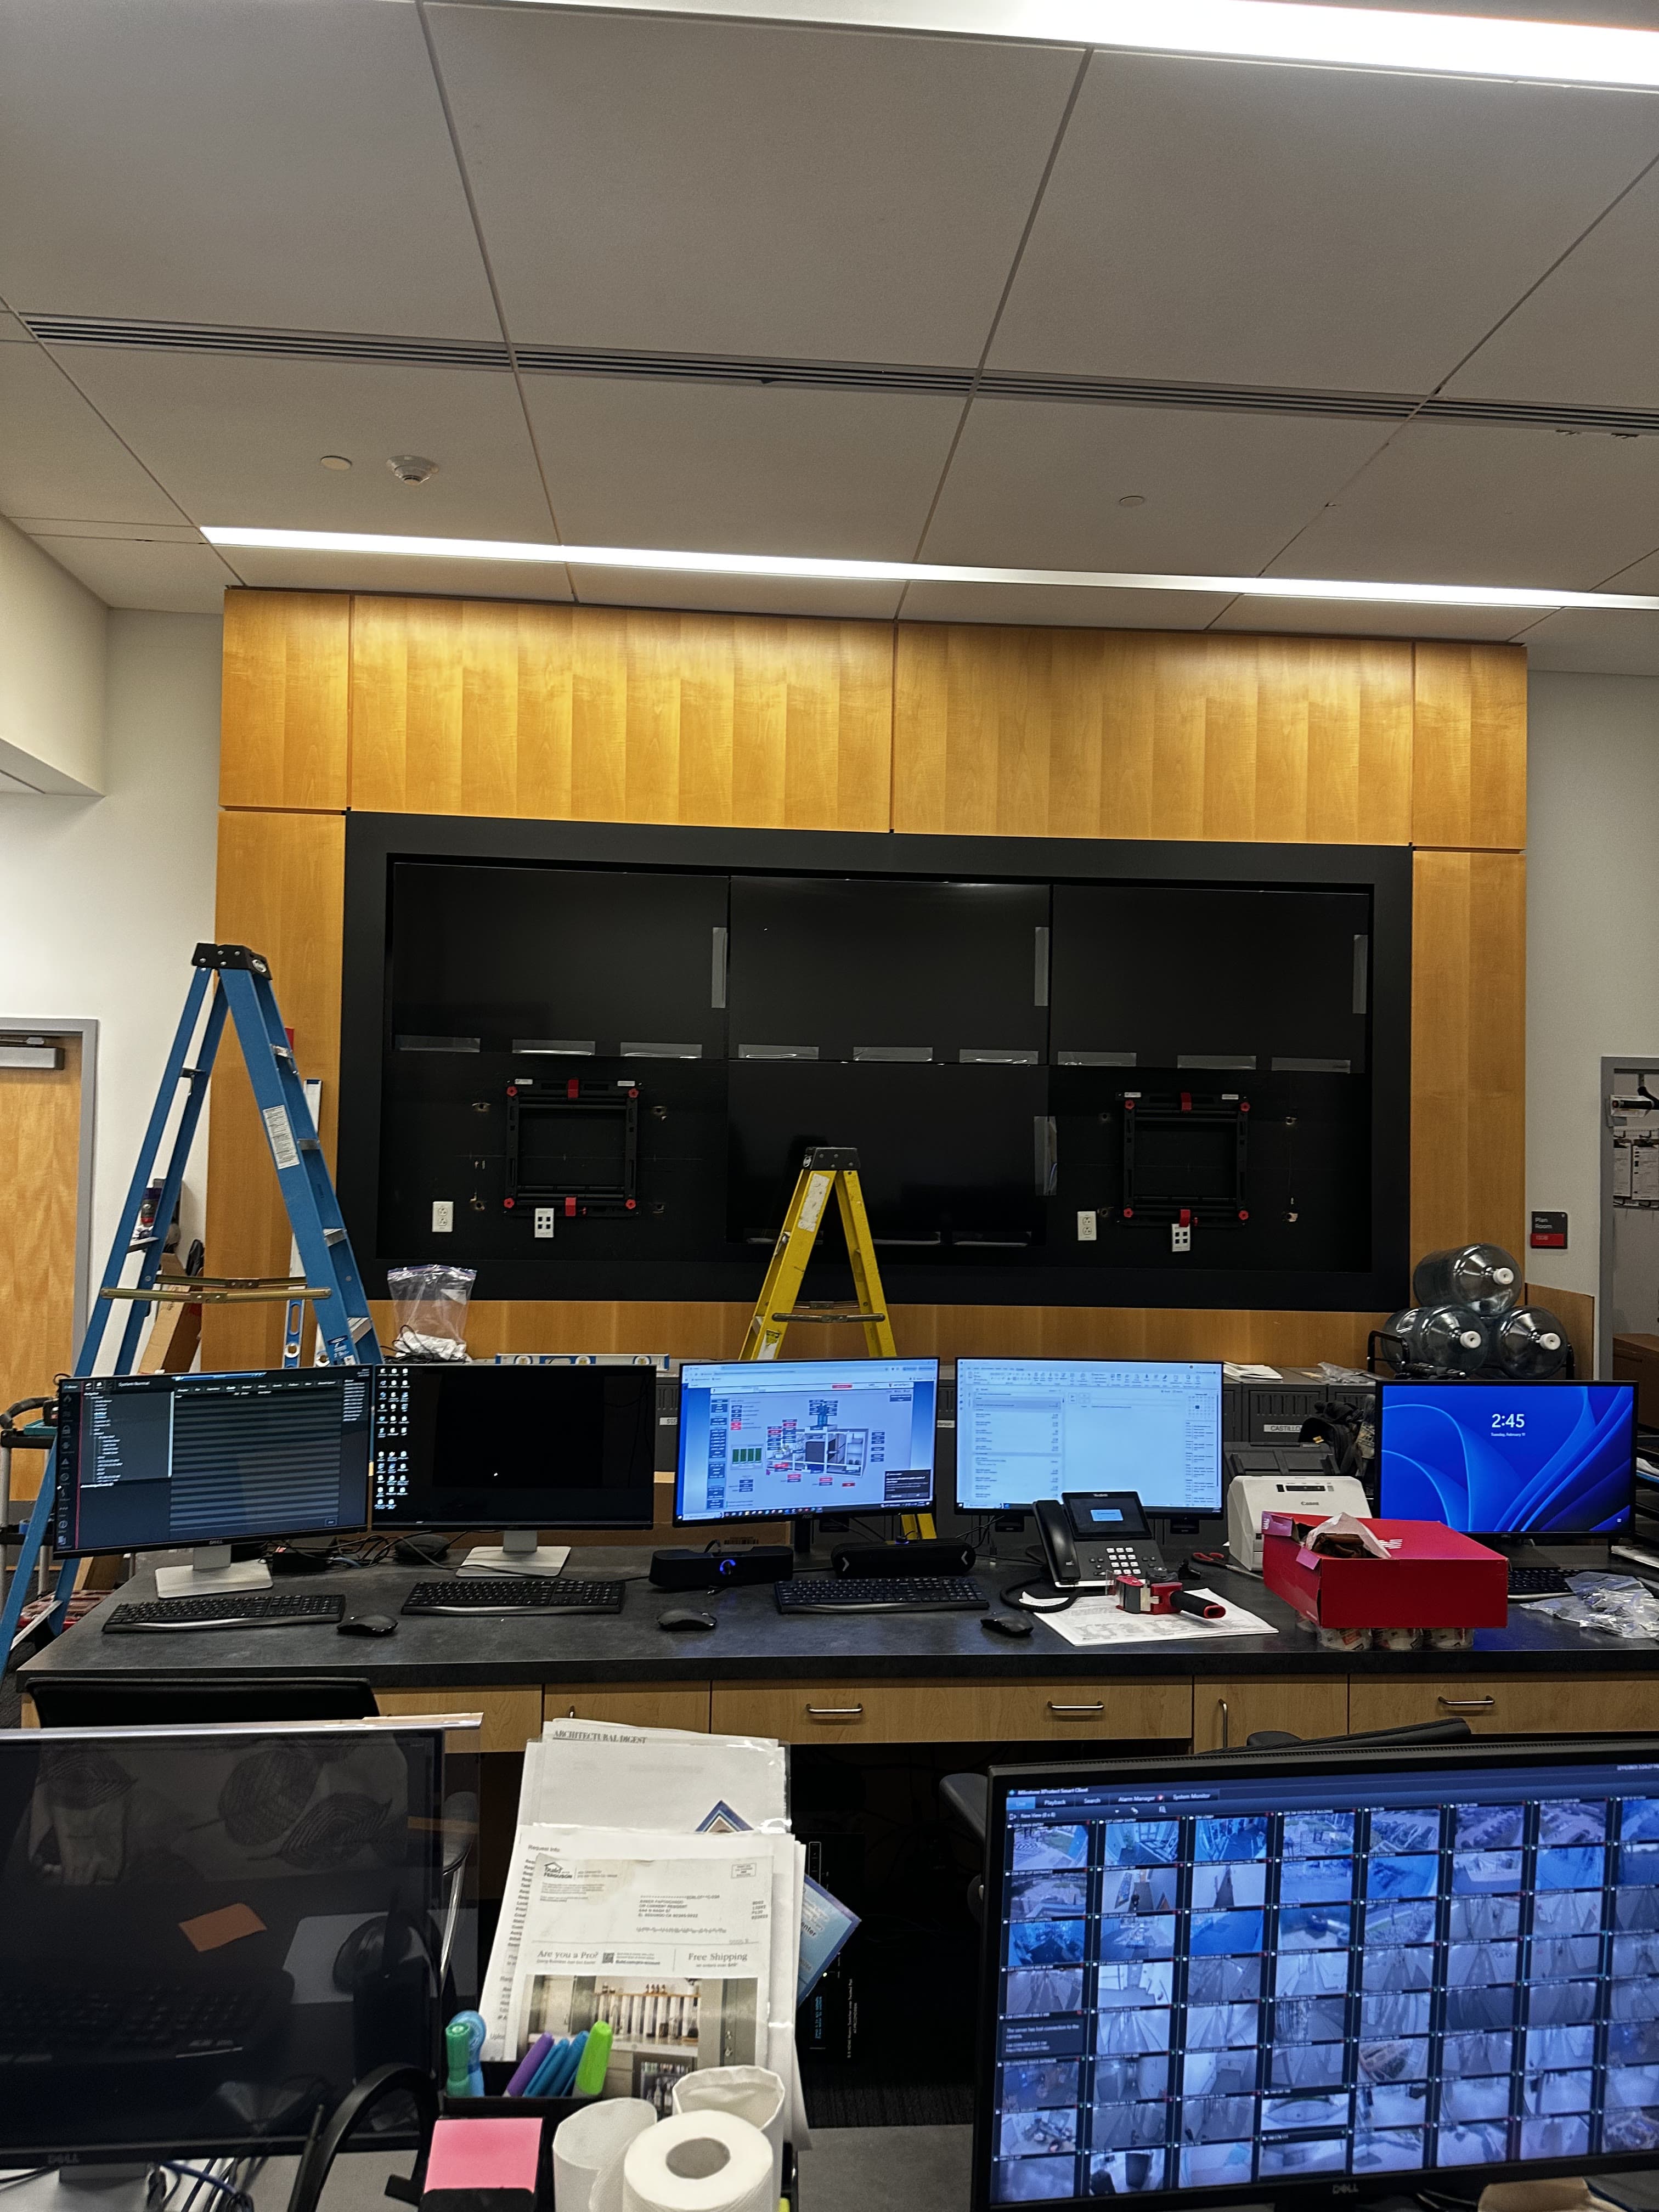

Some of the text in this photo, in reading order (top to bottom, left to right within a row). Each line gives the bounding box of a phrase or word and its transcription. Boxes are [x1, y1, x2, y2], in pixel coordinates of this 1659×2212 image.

[1492, 1413, 1525, 1428] 2:45
[554, 1730, 647, 1743] ARCHITECTURAL DIGEST
[688, 1953, 748, 1962] Free Shipping
[1332, 2183, 1359, 2194] DELL
